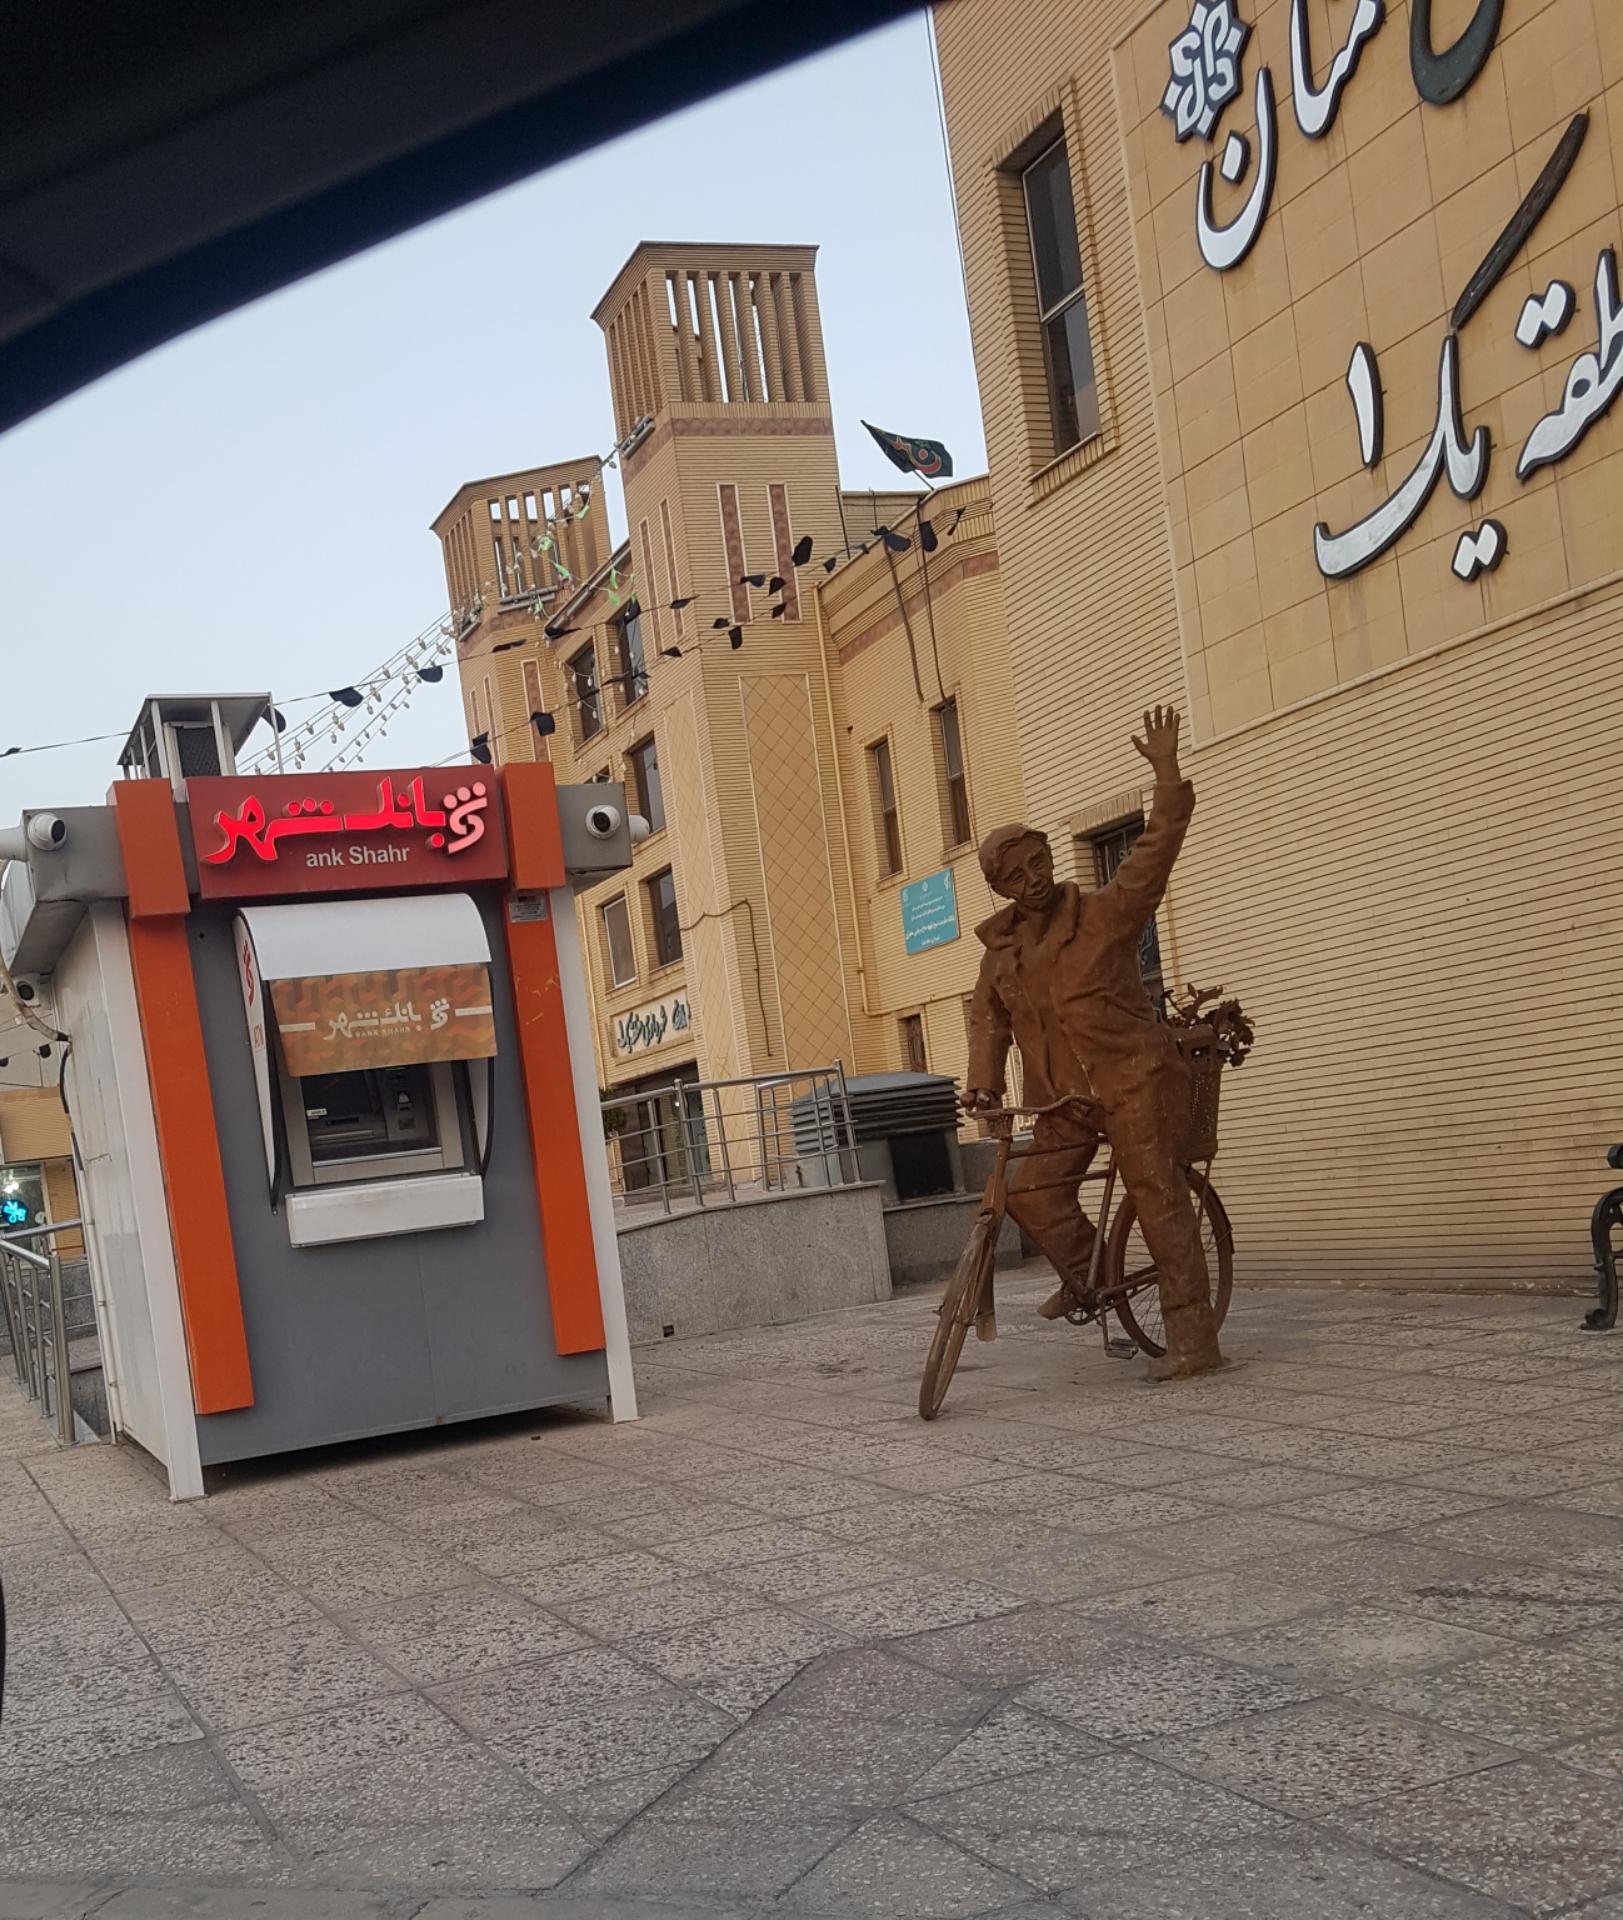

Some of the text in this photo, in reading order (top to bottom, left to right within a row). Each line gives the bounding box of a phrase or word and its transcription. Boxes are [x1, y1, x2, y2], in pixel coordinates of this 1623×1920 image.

[201, 775, 446, 865] بانک شهر
[349, 845, 410, 866] Shahr
[323, 1010, 380, 1041] شهر
